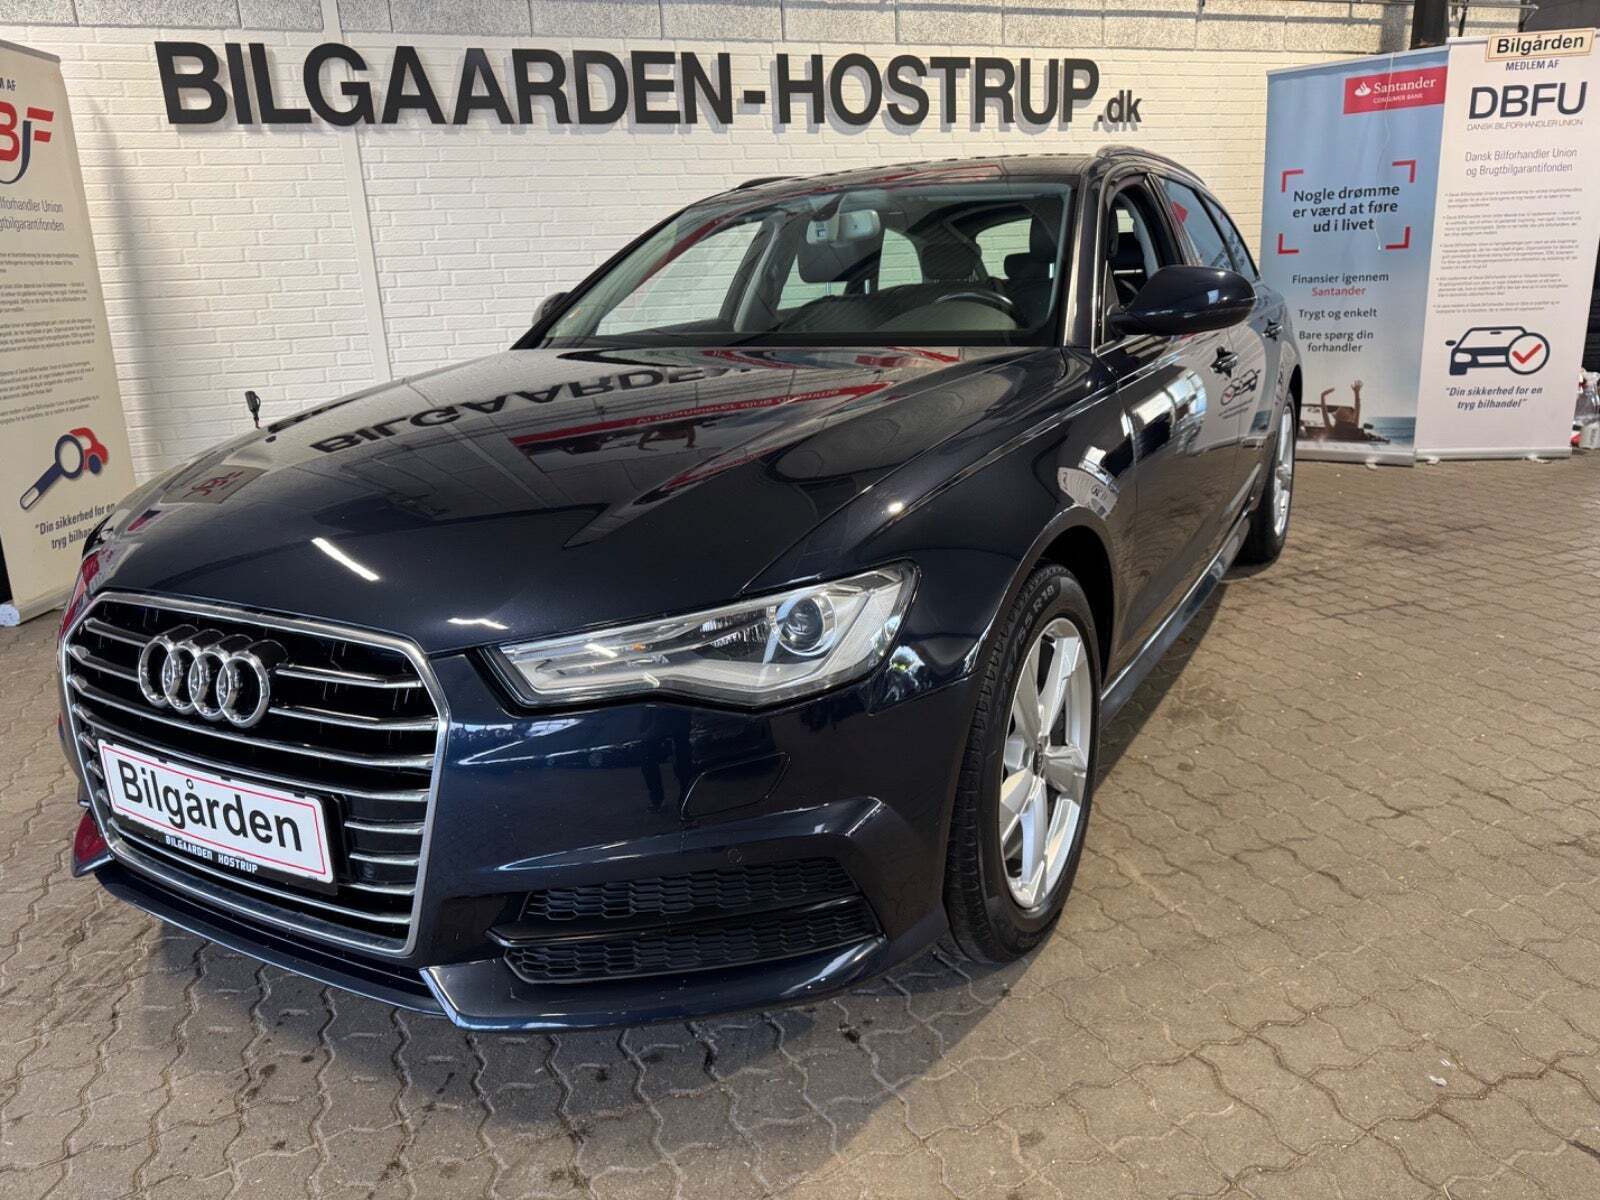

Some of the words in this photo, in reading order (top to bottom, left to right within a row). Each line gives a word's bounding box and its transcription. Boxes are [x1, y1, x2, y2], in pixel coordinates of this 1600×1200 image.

[1496, 34, 1585, 56] Bilgården
[1505, 60, 1545, 71] MEDLEM
[1547, 59, 1560, 69] AF
[1373, 77, 1437, 94] Santander
[1468, 81, 1588, 120] DBFU
[1465, 151, 1493, 162] Dansk
[1494, 148, 1551, 161] Bilforhandler
[1552, 147, 1579, 158] Union
[1466, 167, 1478, 177] og
[1479, 161, 1573, 177] Brugtbilgarantifonden
[1293, 189, 1335, 204] Nogle
[1338, 185, 1400, 200] drømme
[1292, 207, 1310, 218] er
[1311, 203, 1346, 217] værd
[1349, 203, 1364, 214] at
[1368, 200, 1398, 214] føre
[1313, 220, 1330, 233] ud
[1342, 218, 1374, 231] livet
[1292, 274, 1339, 285] Finansier
[1342, 272, 1390, 285] igennem
[1311, 286, 1367, 297] Santander
[1298, 308, 1326, 321] Trygt
[1327, 310, 1341, 320] og
[1343, 307, 1378, 318] enkelt
[1298, 330, 1322, 340] Bare
[1324, 331, 1355, 342] spørg
[1356, 329, 1375, 339] din
[1307, 342, 1364, 353] forhandler
[1467, 386, 1514, 396] sikkerhed
[1515, 385, 1529, 395] for
[1530, 386, 1543, 394] en
[1457, 400, 1476, 411] tryg
[55, 506, 94, 531] sikkerhed
[94, 504, 105, 516] for
[51, 536, 67, 549] tryg
[116, 759, 303, 853] Bilgården
[165, 835, 213, 861] BILGAARDEN
[217, 852, 258, 874] HOSTRUP
